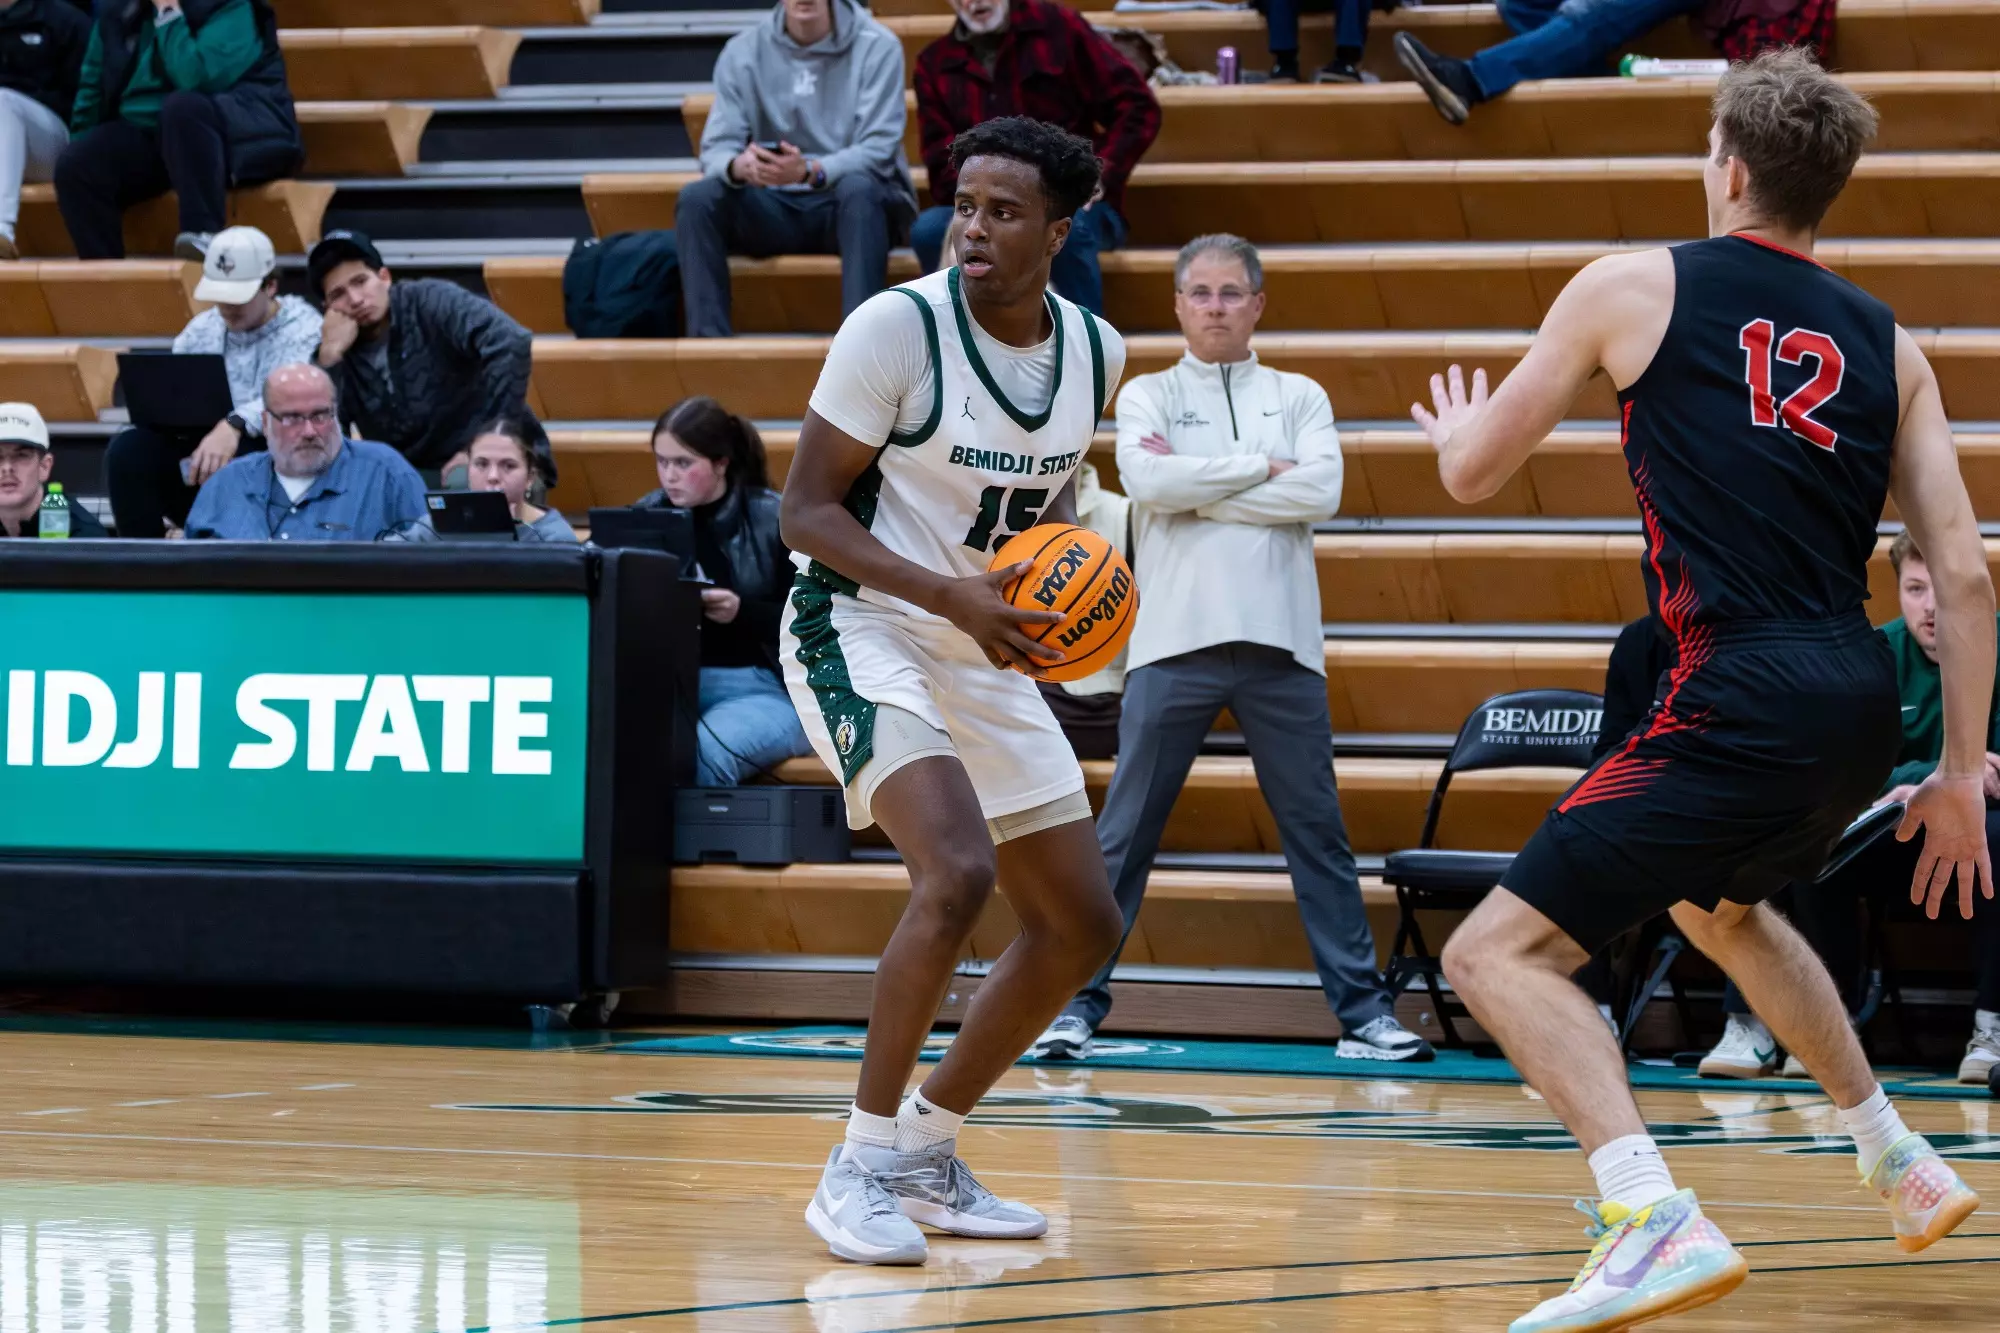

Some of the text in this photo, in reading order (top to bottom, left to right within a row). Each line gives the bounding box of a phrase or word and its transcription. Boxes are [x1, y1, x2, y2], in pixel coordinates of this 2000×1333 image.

[1739, 318, 1845, 452] 12
[949, 445, 1081, 475] BEMIDJI STATE
[962, 485, 1050, 554] 15
[1033, 542, 1092, 608] NCAA
[1056, 566, 1130, 648] Wilson
[228, 672, 553, 776] STATE
[1482, 735, 1600, 746] STATE UNIVERSITY
[1483, 708, 1604, 736] BEMIDJI
